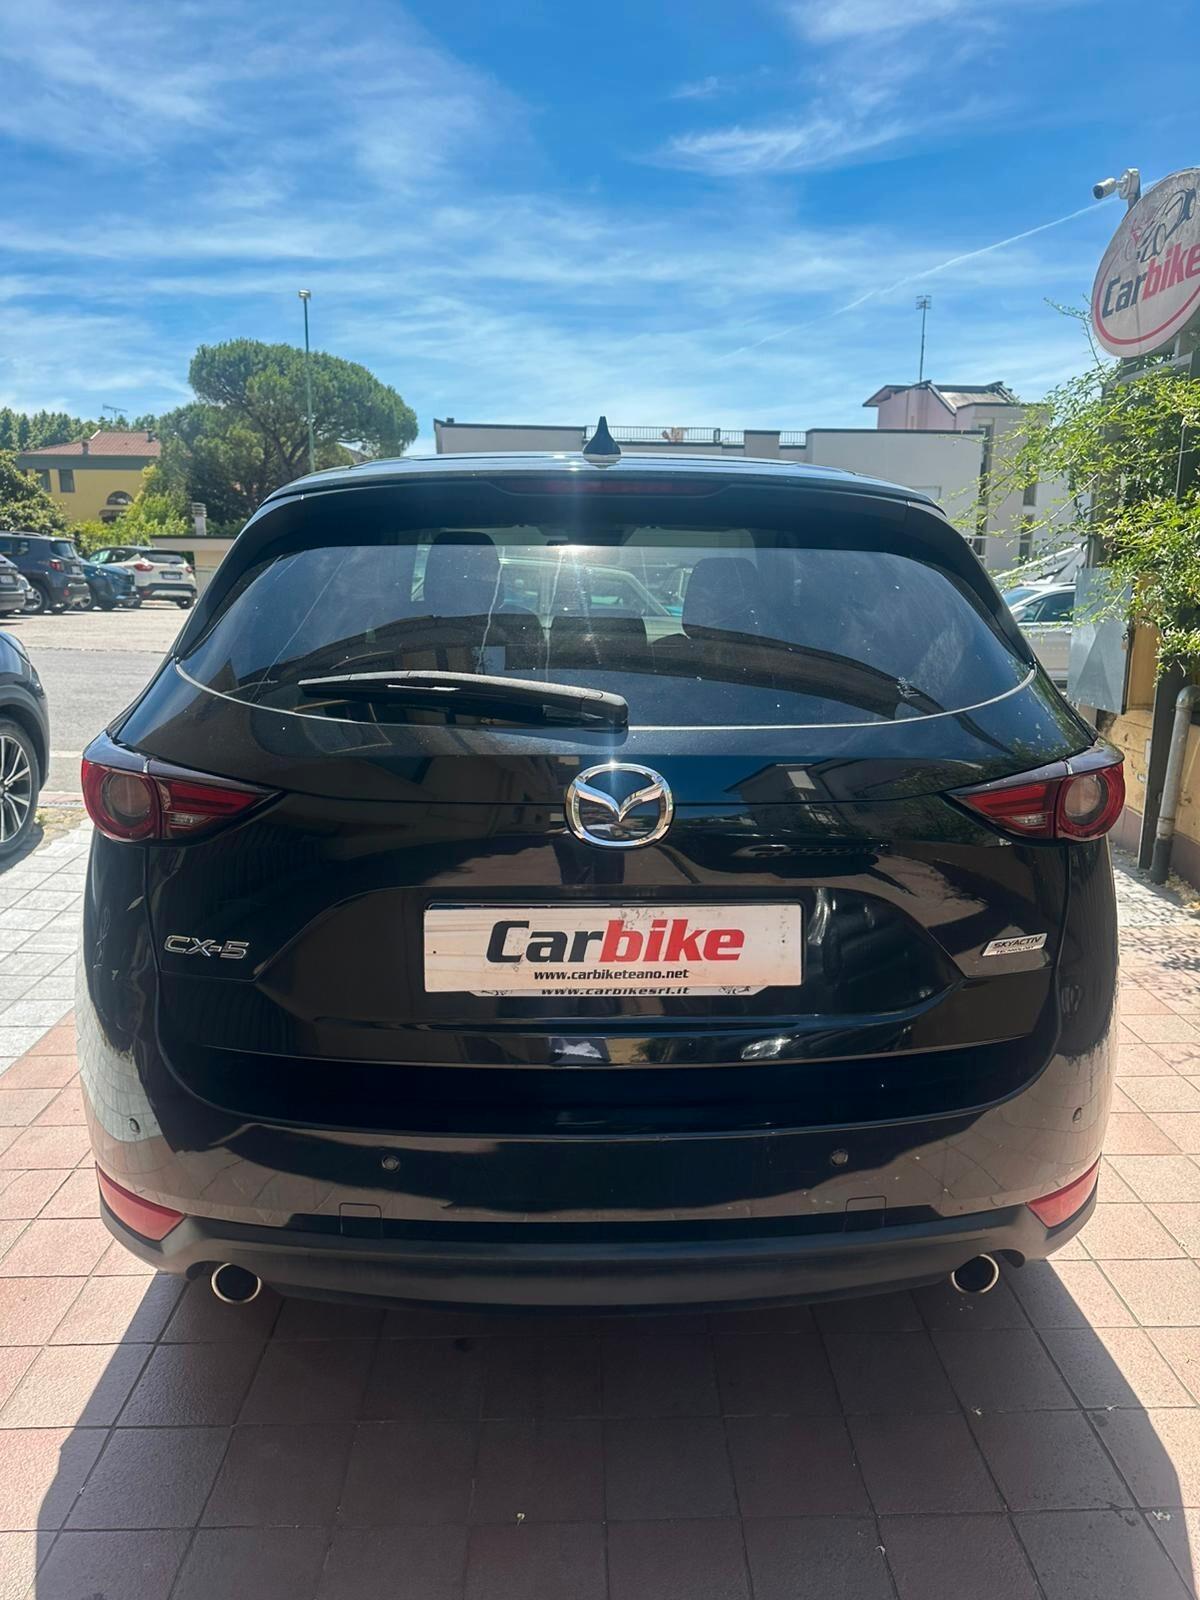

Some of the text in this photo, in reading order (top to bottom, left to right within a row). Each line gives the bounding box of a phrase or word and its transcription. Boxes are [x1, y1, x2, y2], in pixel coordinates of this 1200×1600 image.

[1102, 242, 1200, 319] Carbike
[164, 935, 249, 959] CX-5
[486, 919, 745, 963] Carbike
[994, 936, 1042, 948] SKYACTIV
[534, 969, 689, 980] www.carbiketeano.net
